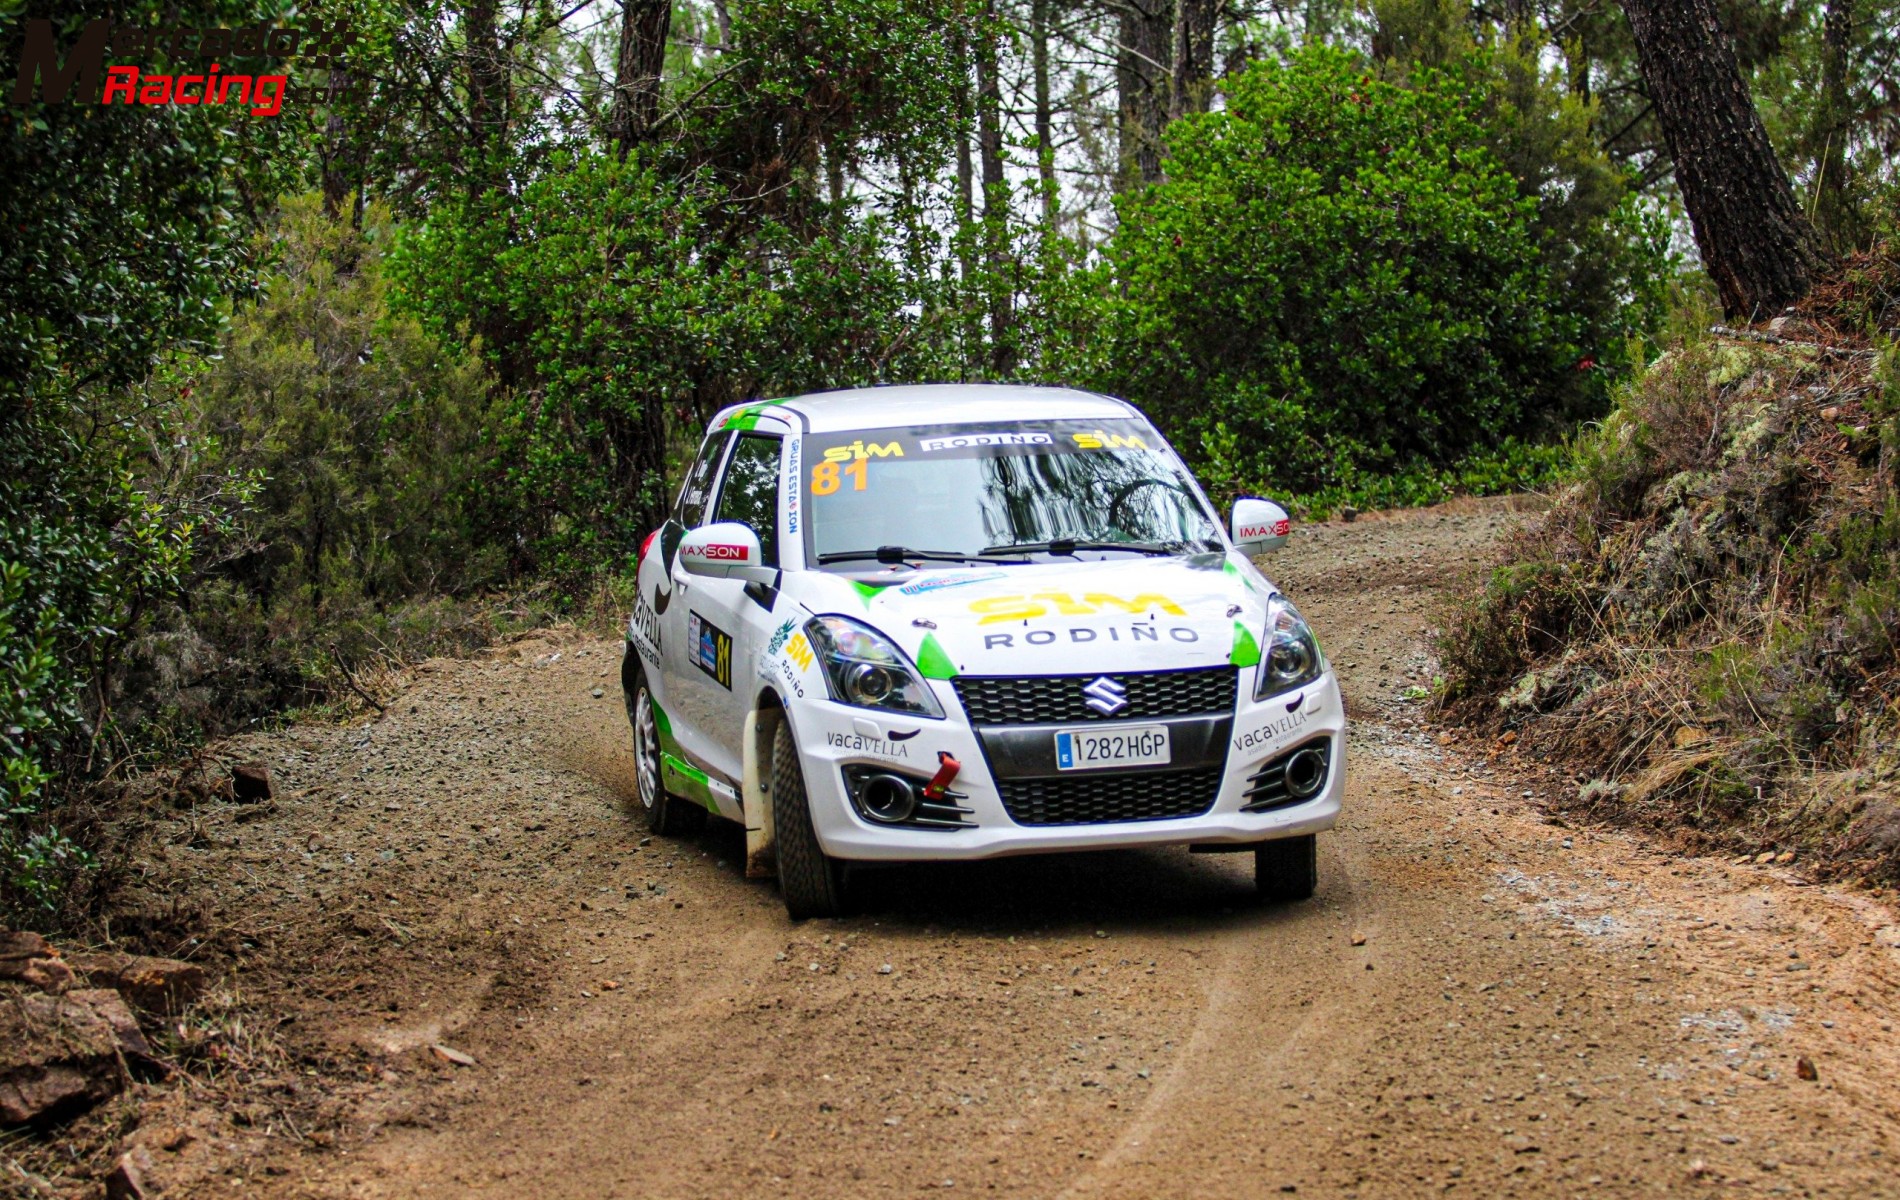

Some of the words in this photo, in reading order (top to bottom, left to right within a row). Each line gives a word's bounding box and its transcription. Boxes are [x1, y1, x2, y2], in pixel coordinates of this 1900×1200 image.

[789, 438, 800, 474] GRUAS
[810, 458, 869, 496] 81
[984, 622, 1199, 650] RODIÑO
[717, 633, 730, 687] 81
[781, 659, 804, 698] RODIÑO
[827, 731, 908, 758] vacaVELLA
[1233, 711, 1307, 751] vacaVELLA
[1062, 754, 1069, 762] E
